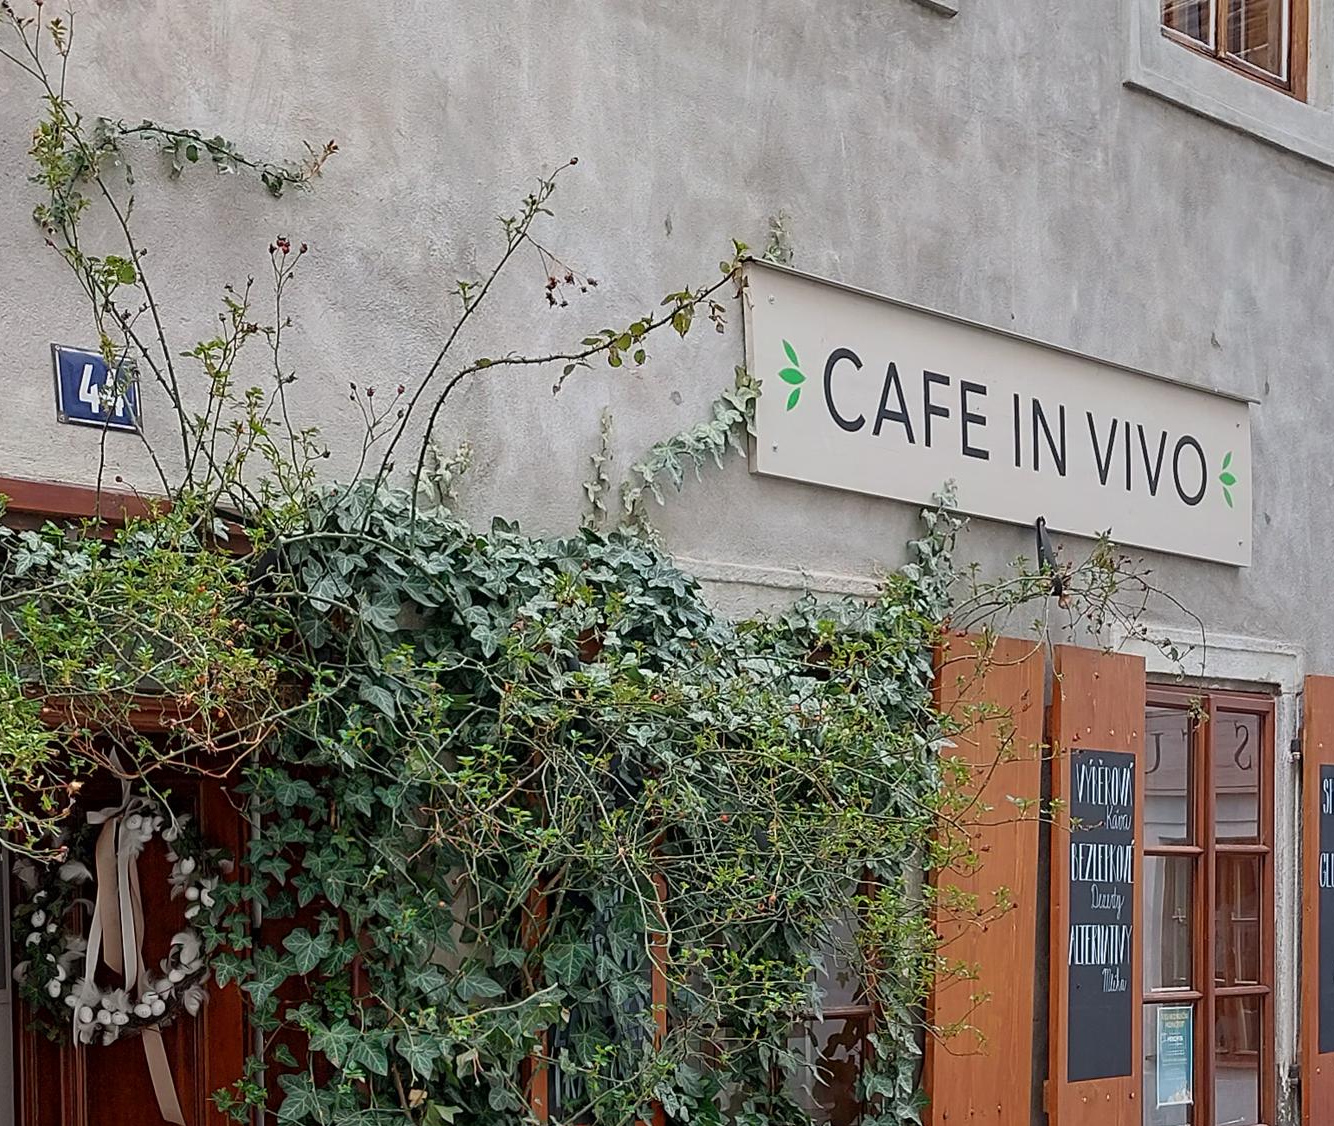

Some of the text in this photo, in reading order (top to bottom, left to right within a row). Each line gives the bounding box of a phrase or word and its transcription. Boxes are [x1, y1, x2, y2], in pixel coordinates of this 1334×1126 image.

[823, 347, 1208, 506] CAFE IN VIVO
[1075, 758, 1134, 807] VÝBĚROVÁ
